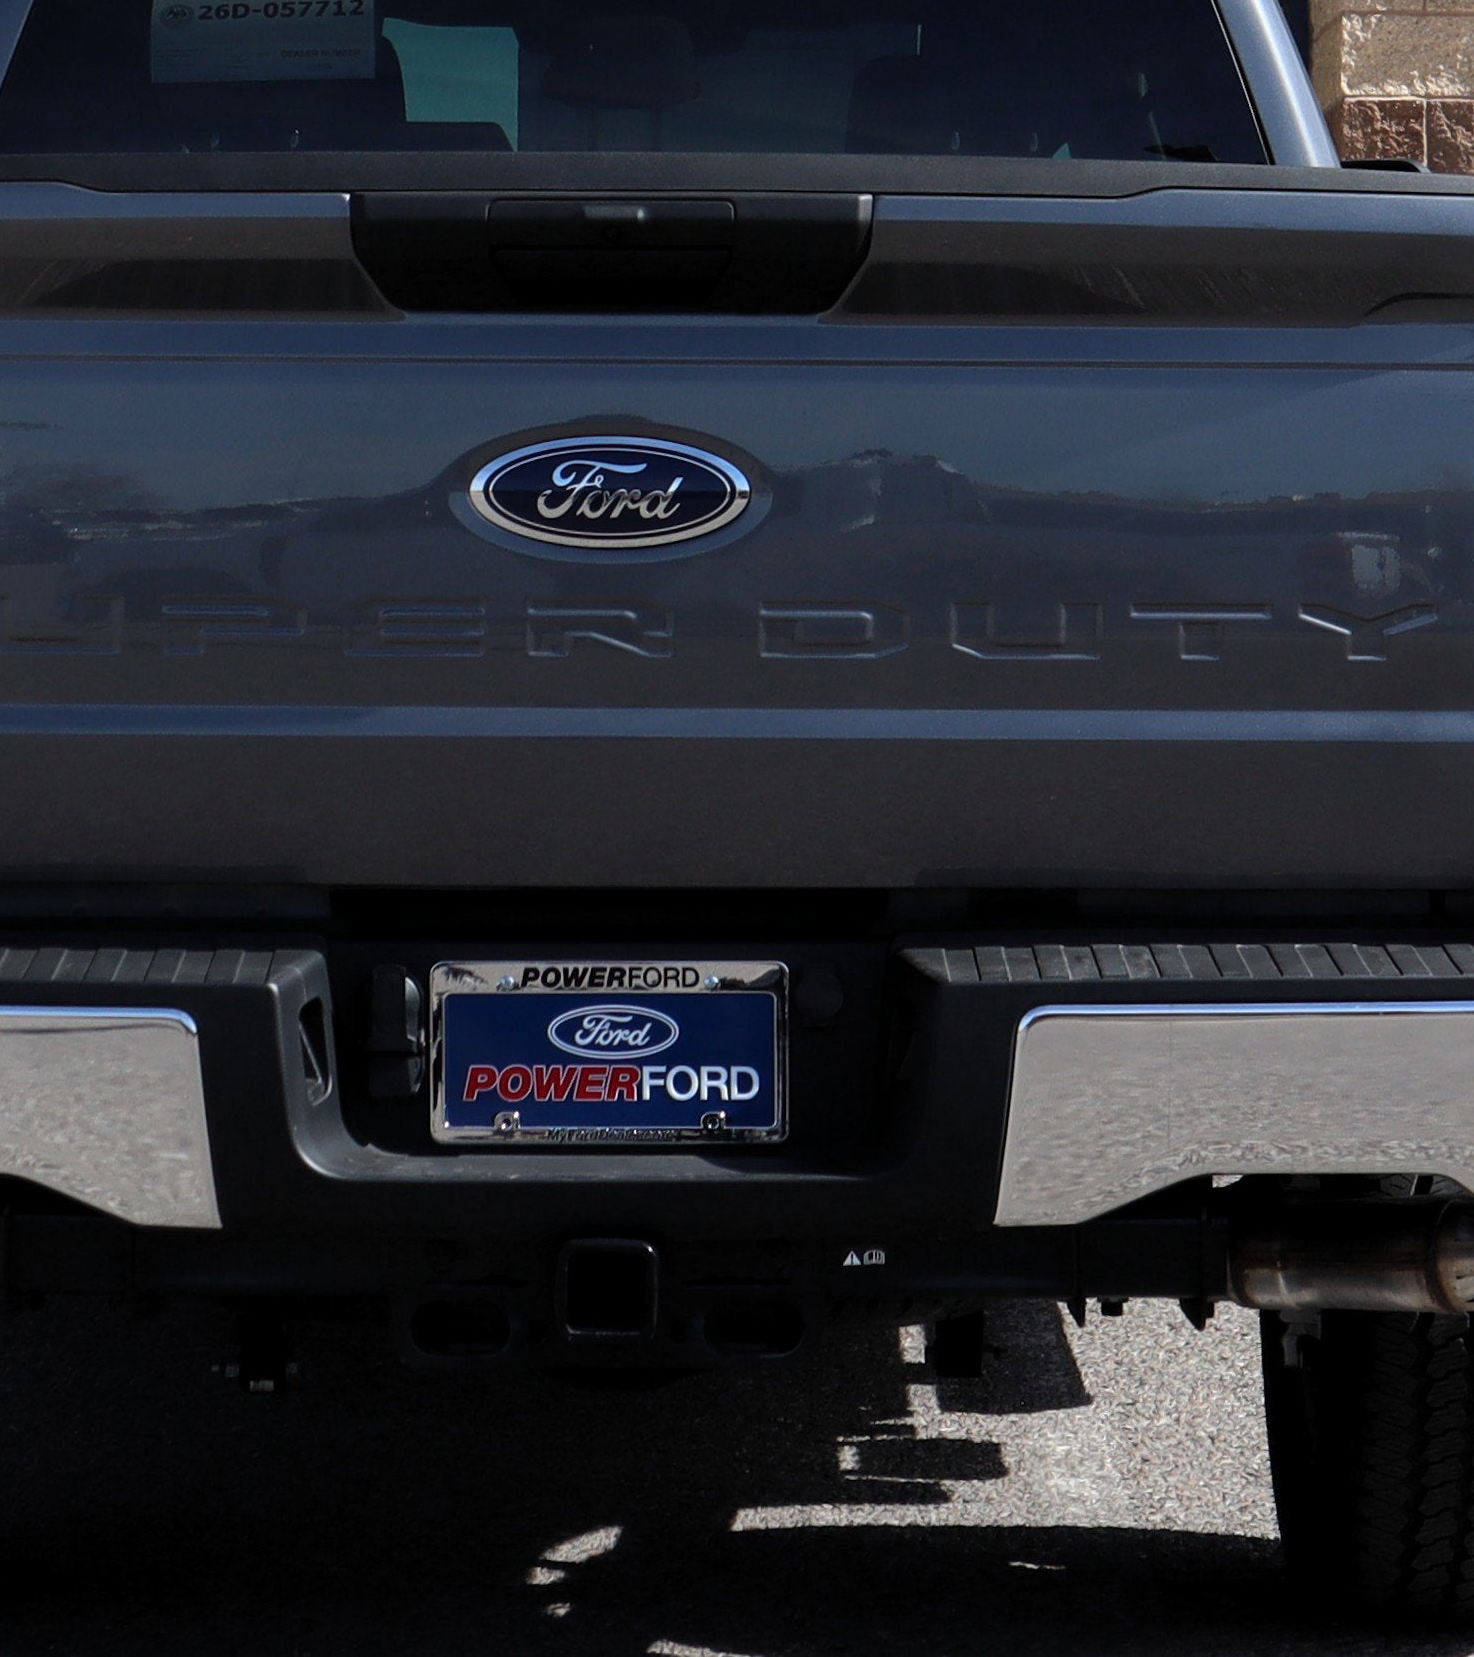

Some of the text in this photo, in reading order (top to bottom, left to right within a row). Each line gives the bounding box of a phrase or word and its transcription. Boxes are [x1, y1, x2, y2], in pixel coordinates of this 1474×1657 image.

[536, 459, 684, 520] Ford
[758, 599, 1439, 662] DUTY
[520, 966, 701, 990] POWERFORD
[574, 1013, 653, 1047] Ford
[462, 1063, 761, 1103] POWERFORD
